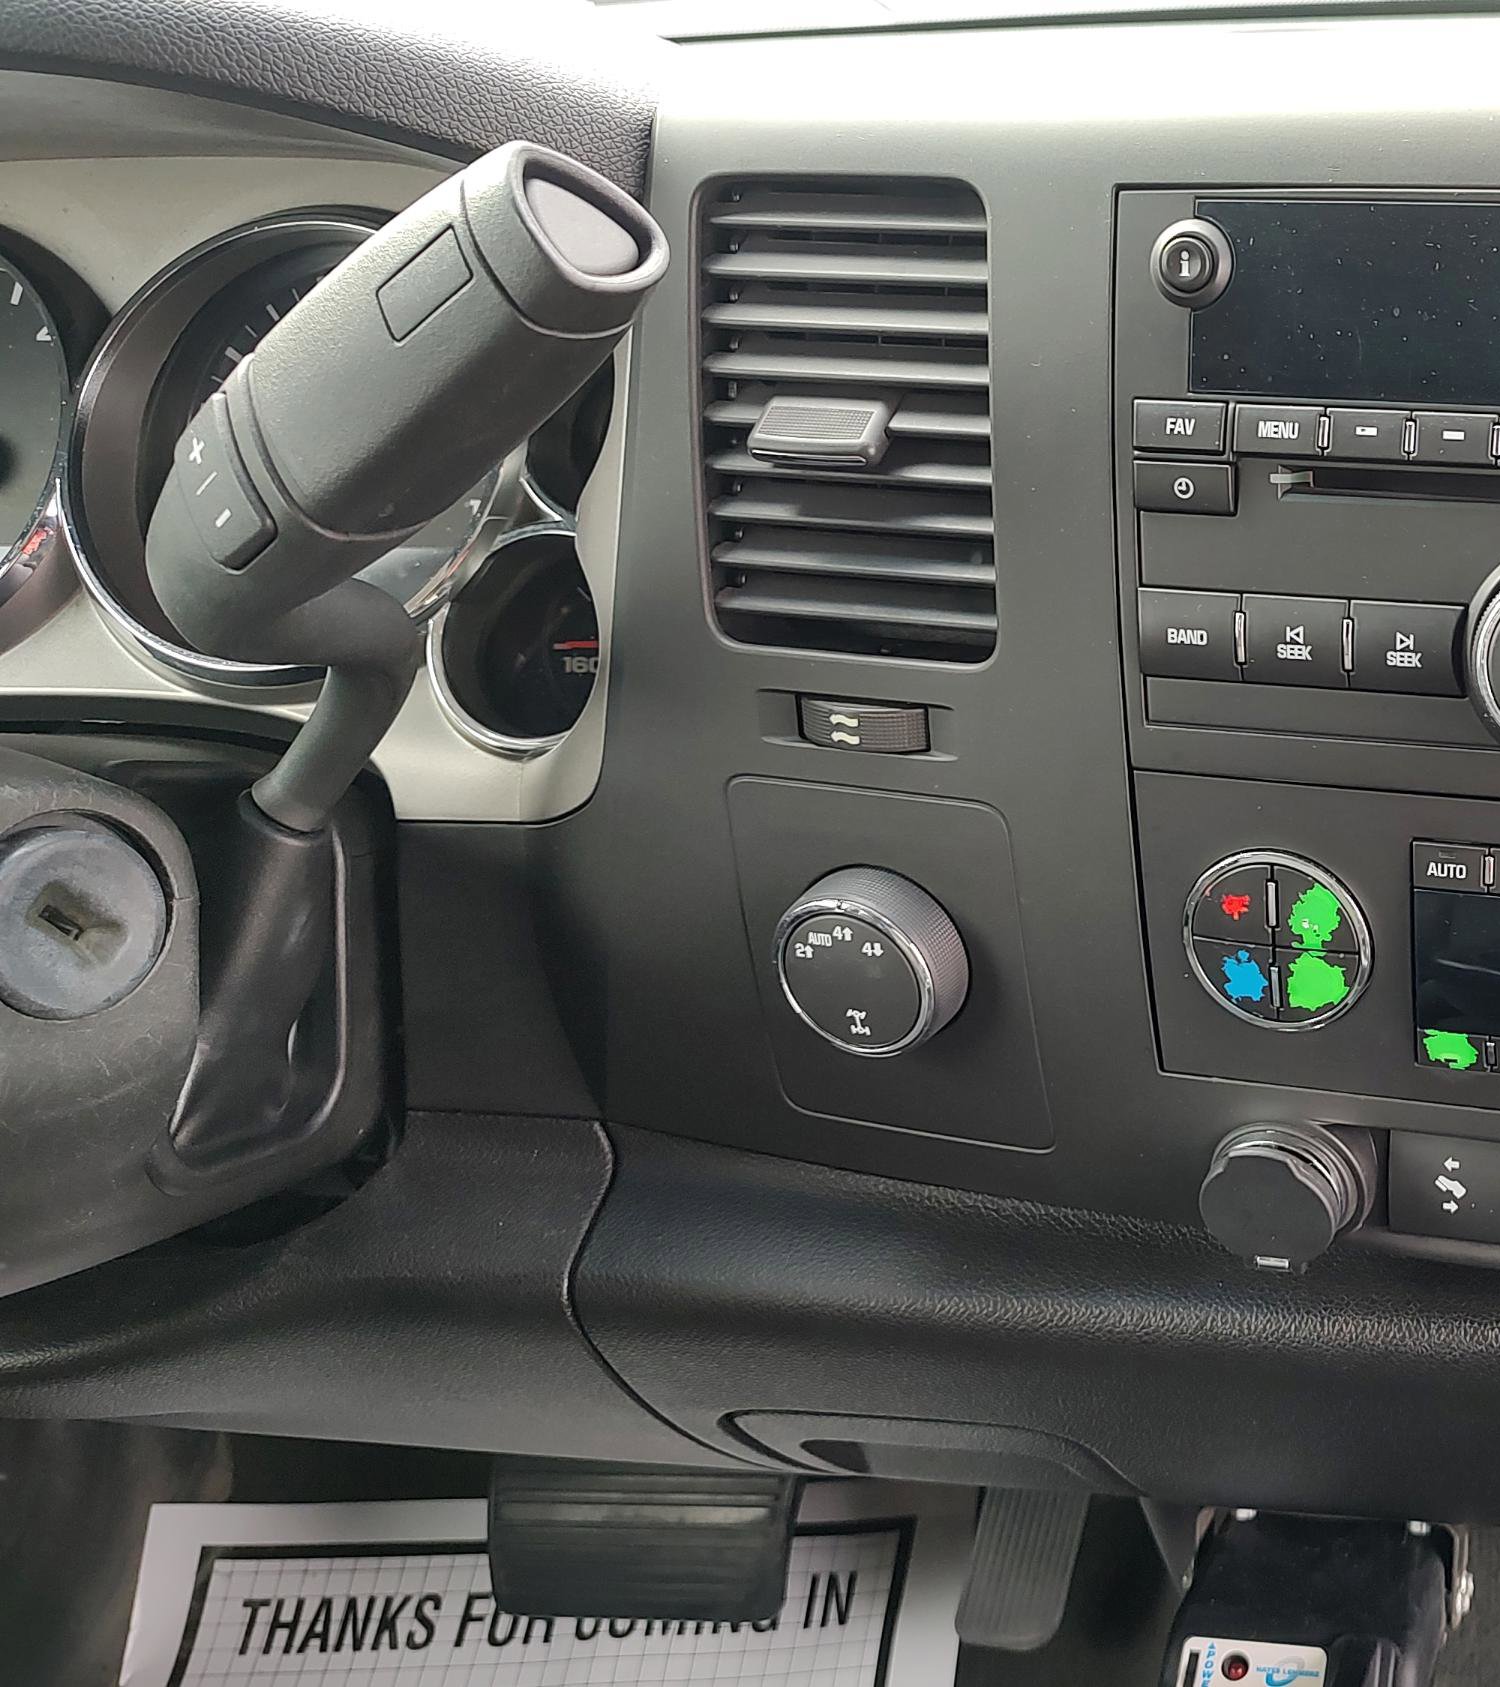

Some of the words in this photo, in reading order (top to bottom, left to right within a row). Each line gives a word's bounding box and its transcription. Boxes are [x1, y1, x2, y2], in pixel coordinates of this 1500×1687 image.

[1165, 417, 1196, 436] FAV
[1257, 420, 1300, 440] MENU
[1167, 627, 1208, 647] BAND
[1276, 643, 1312, 661] SEEK
[1386, 651, 1422, 668] SEEK
[1426, 860, 1467, 880] AUTO
[807, 931, 833, 948] AUTO
[238, 1592, 442, 1655] THANKS
[803, 1570, 858, 1629] IN
